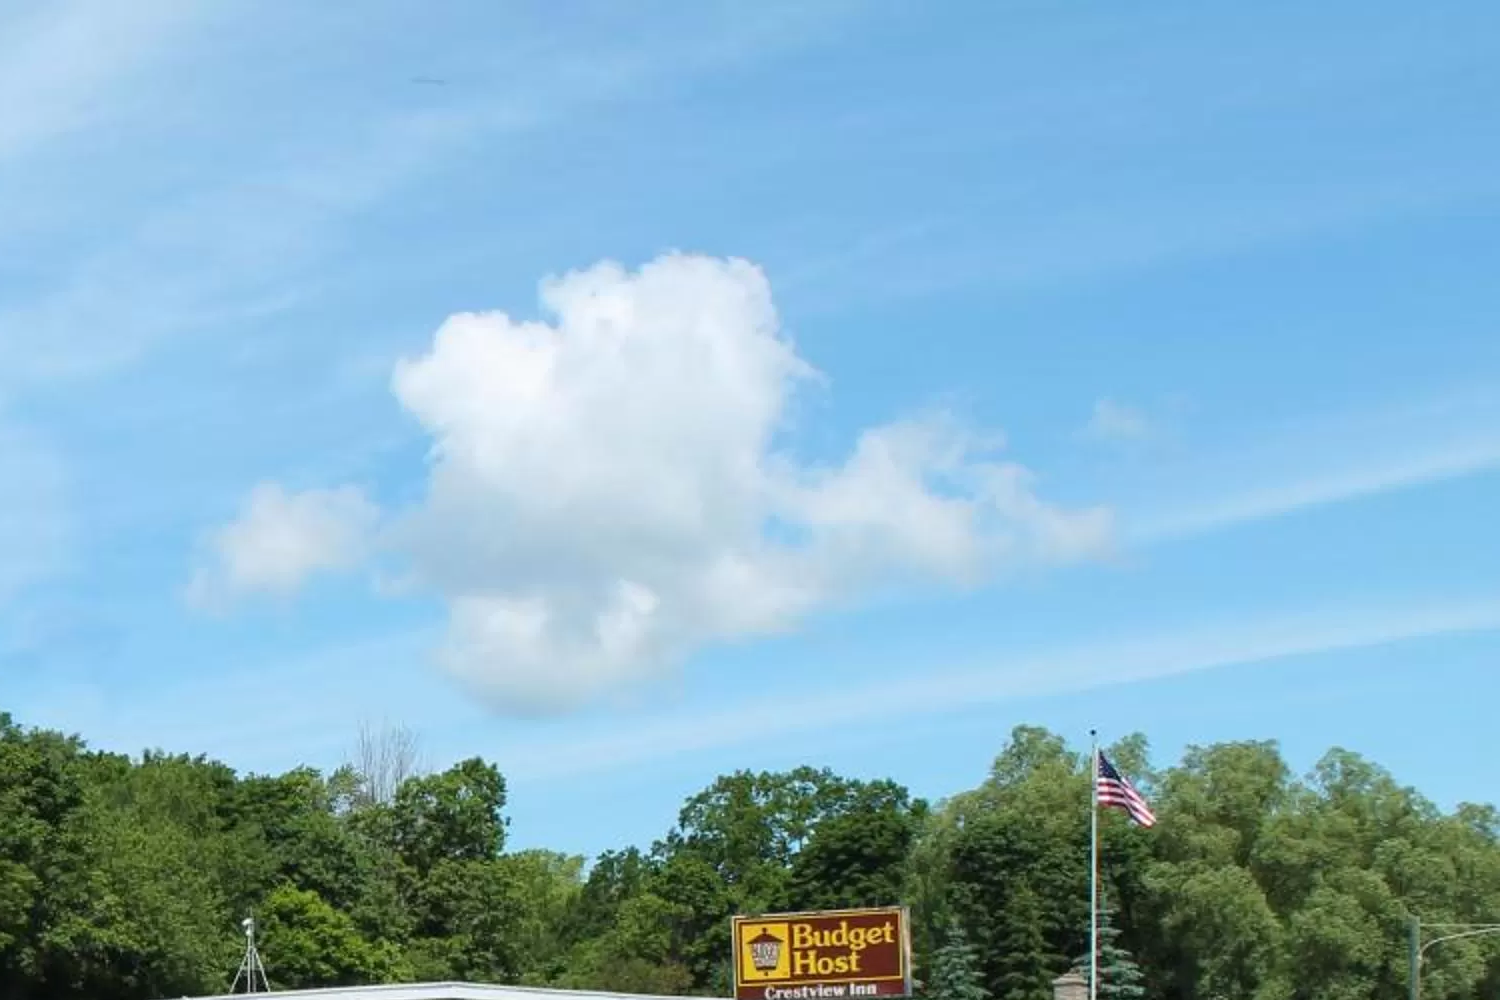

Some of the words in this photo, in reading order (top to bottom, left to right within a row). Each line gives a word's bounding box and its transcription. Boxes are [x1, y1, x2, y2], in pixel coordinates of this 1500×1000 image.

[792, 921, 895, 950] Budget
[792, 950, 861, 976] Host
[764, 984, 846, 1000] Crestview
[849, 983, 877, 996] Inn
